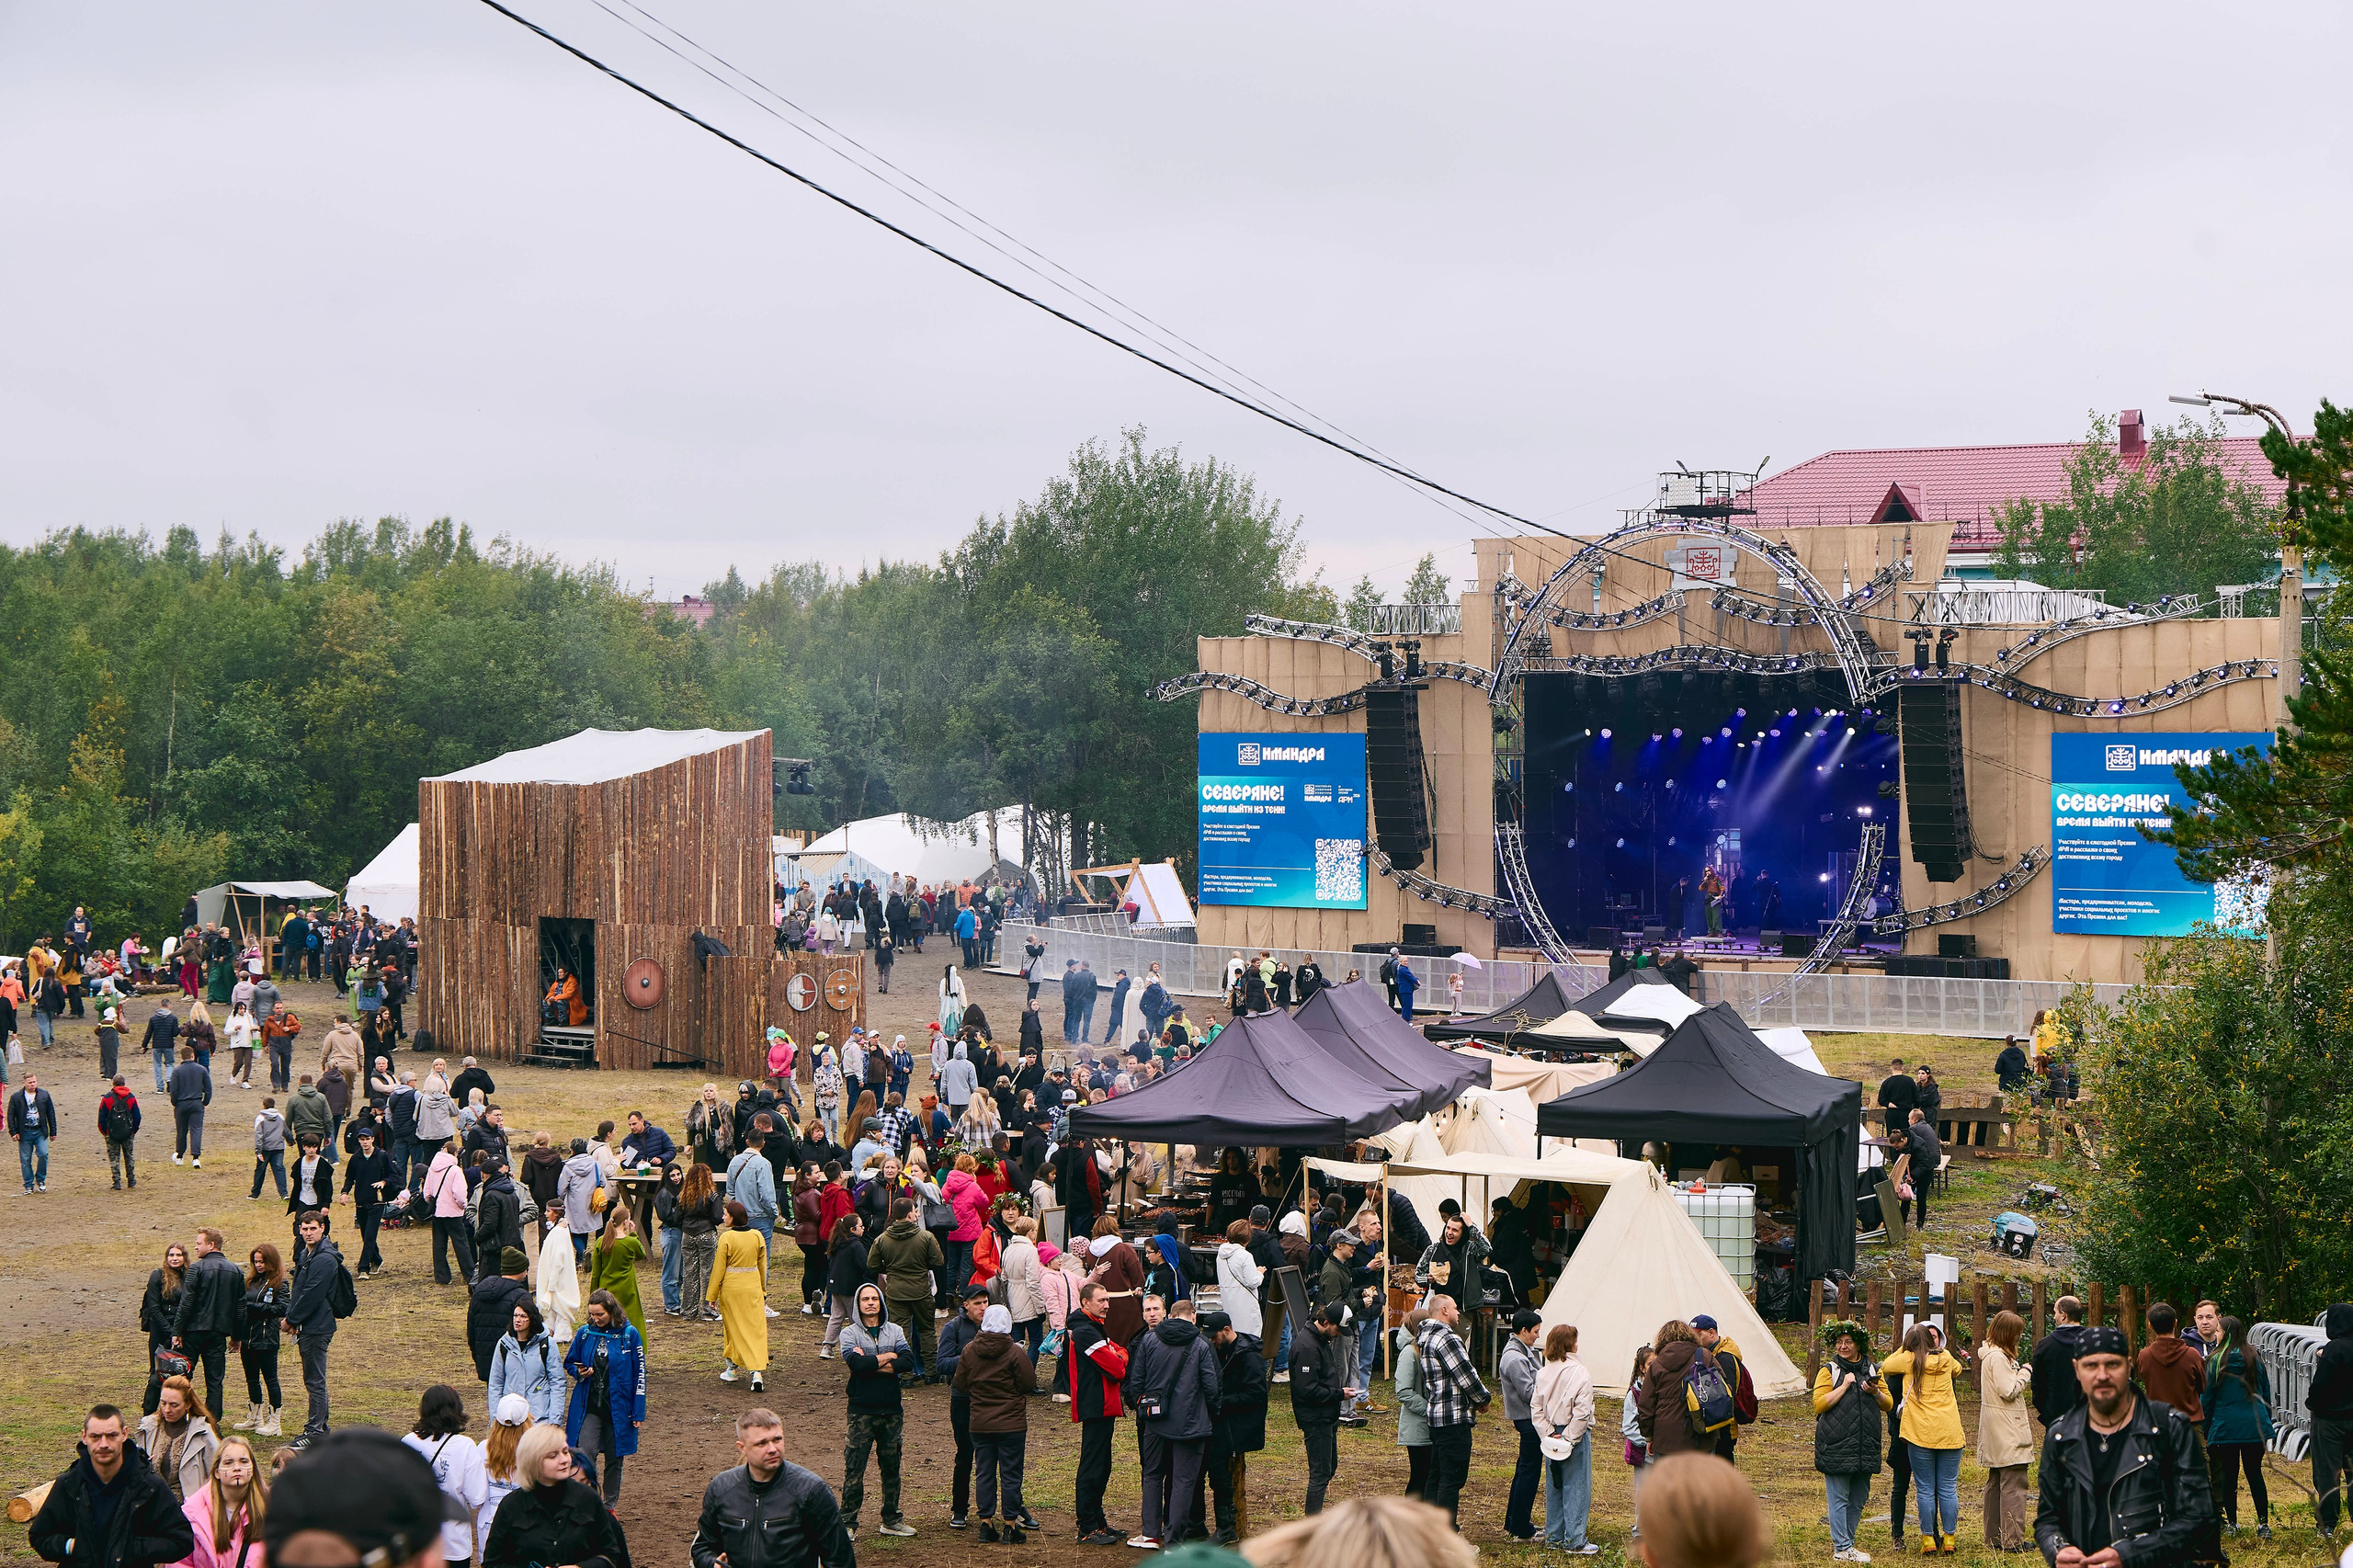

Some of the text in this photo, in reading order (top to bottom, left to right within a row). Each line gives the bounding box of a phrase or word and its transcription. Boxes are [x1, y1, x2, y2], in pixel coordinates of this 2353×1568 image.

[1262, 747, 1324, 762] ИМАНДРА
[2140, 749, 2227, 767] ИМАНДР
[1202, 784, 1284, 801] СЕВЕРЯНЕ!
[1202, 804, 1227, 812] ВРЕМЯ
[1228, 803, 1253, 813] ВЫЙТИ
[2056, 817, 2090, 826] ВРЕМЯ
[2092, 816, 2126, 827] ВЫЙТИ
[2142, 818, 2172, 828] ТЕНИ!
